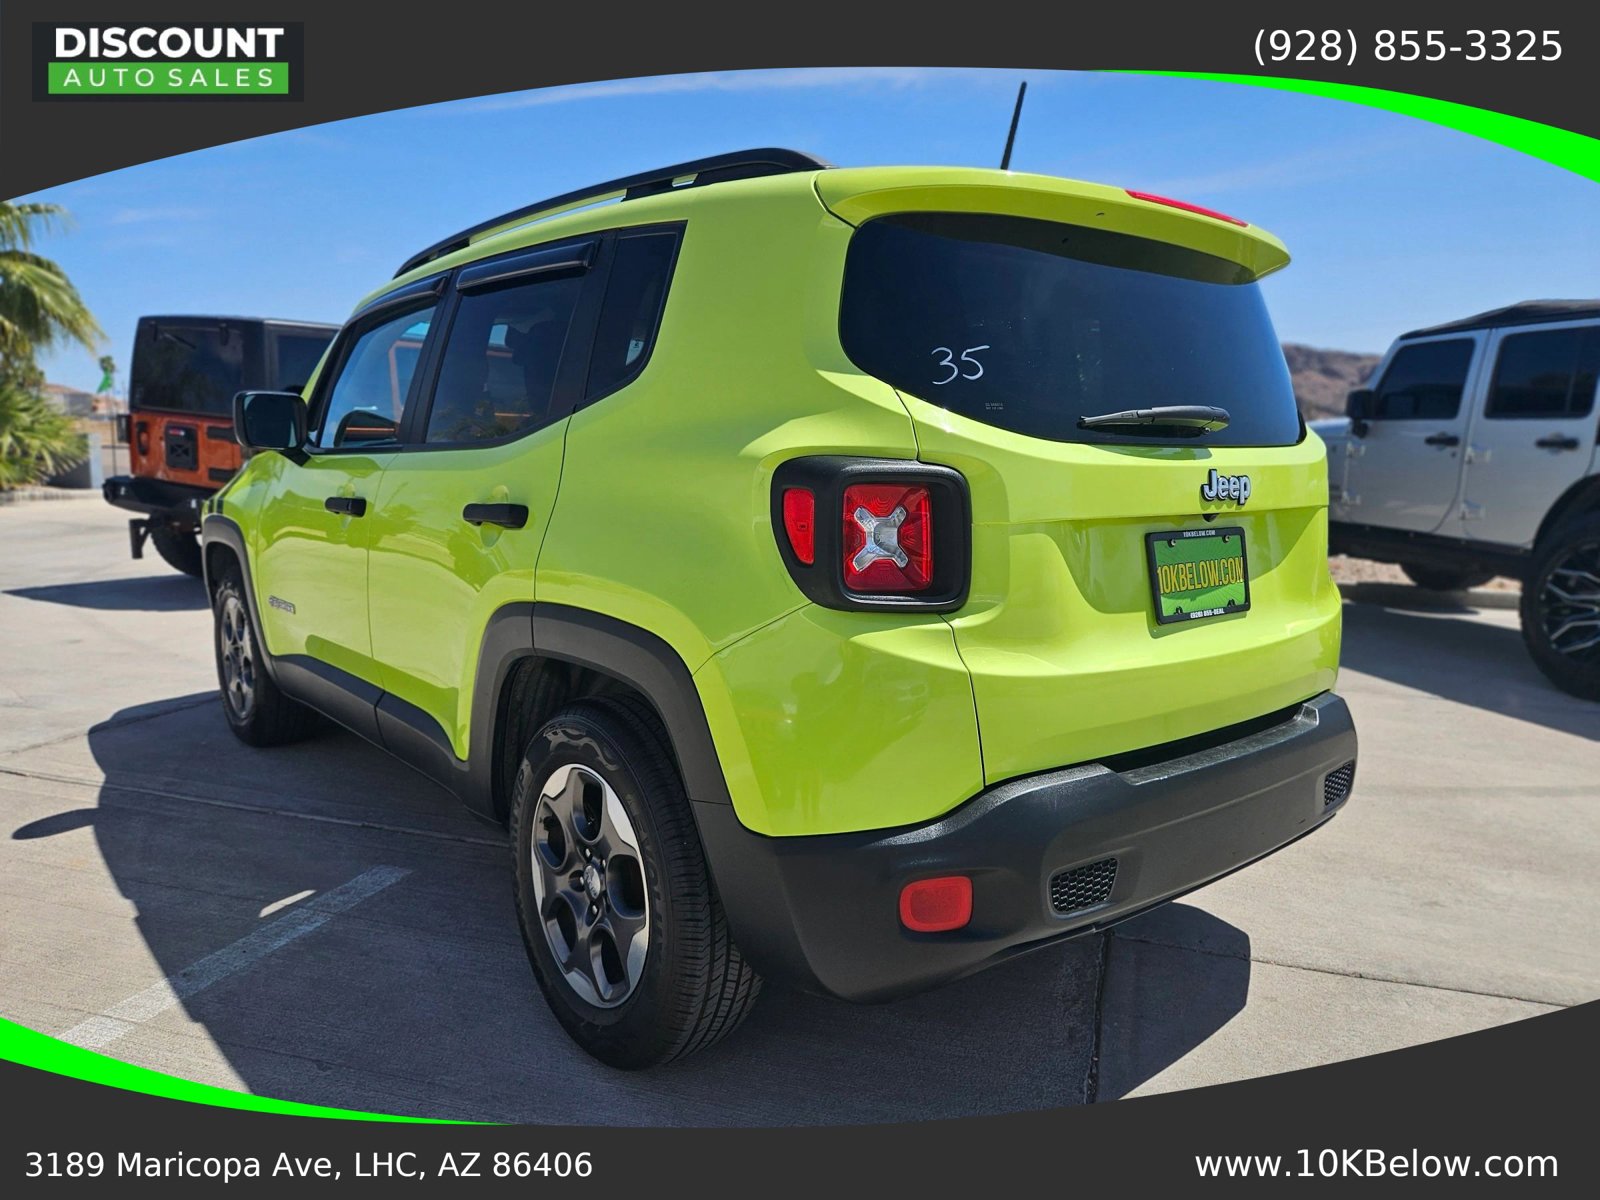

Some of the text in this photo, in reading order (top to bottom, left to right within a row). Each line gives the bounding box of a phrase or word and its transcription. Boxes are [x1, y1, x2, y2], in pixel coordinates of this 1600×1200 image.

[931, 345, 990, 385] 35
[1201, 469, 1251, 505] Jeep
[1157, 557, 1244, 594] 10KBELOW.COM
